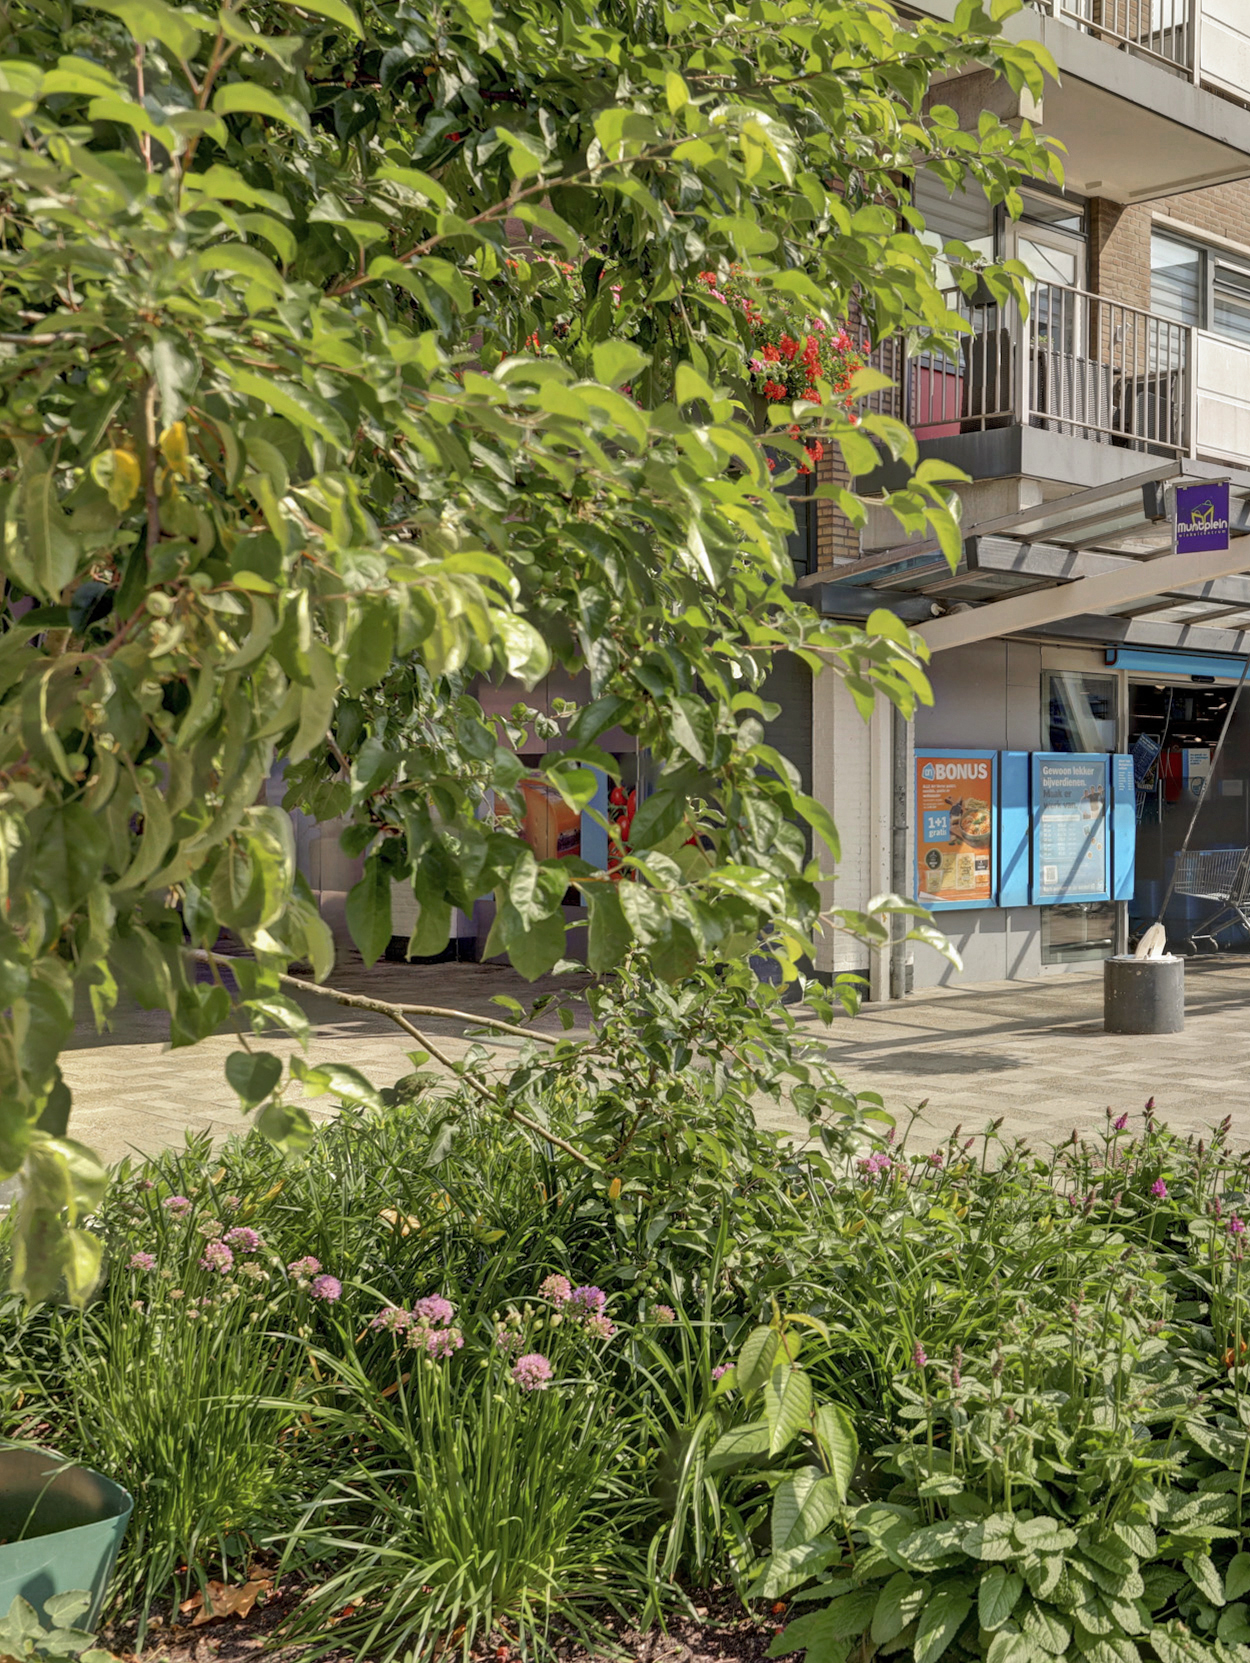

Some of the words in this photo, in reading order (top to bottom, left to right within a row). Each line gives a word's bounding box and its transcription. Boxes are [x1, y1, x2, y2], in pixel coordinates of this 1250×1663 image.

[935, 763, 988, 780] BONUS
[1043, 766, 1072, 775] Gewoon
[1073, 766, 1094, 775] lekker
[1043, 778, 1087, 788] bijverdienen.
[1043, 789, 1063, 798] Maak
[928, 817, 947, 829] 1+1
[929, 828, 947, 838] gratis
